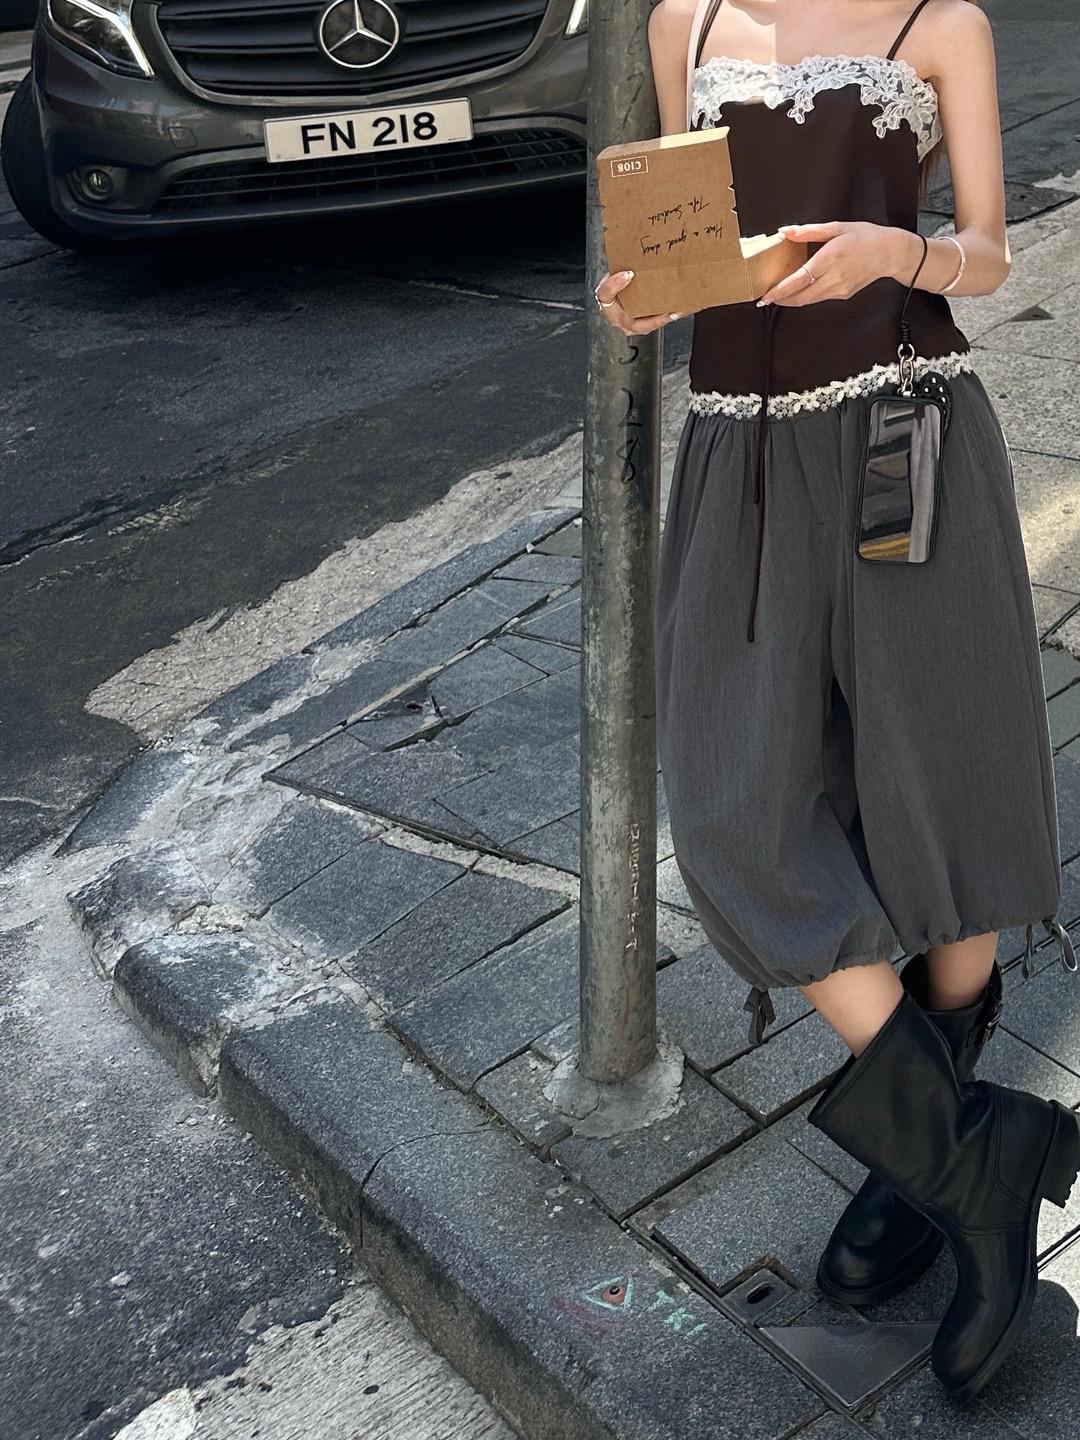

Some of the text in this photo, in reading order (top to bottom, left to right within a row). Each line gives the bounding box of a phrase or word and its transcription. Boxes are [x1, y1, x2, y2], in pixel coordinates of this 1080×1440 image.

[301, 111, 438, 154] FN 218
[667, 227, 688, 252] good
[704, 220, 724, 239] Have
[640, 236, 661, 256] day
